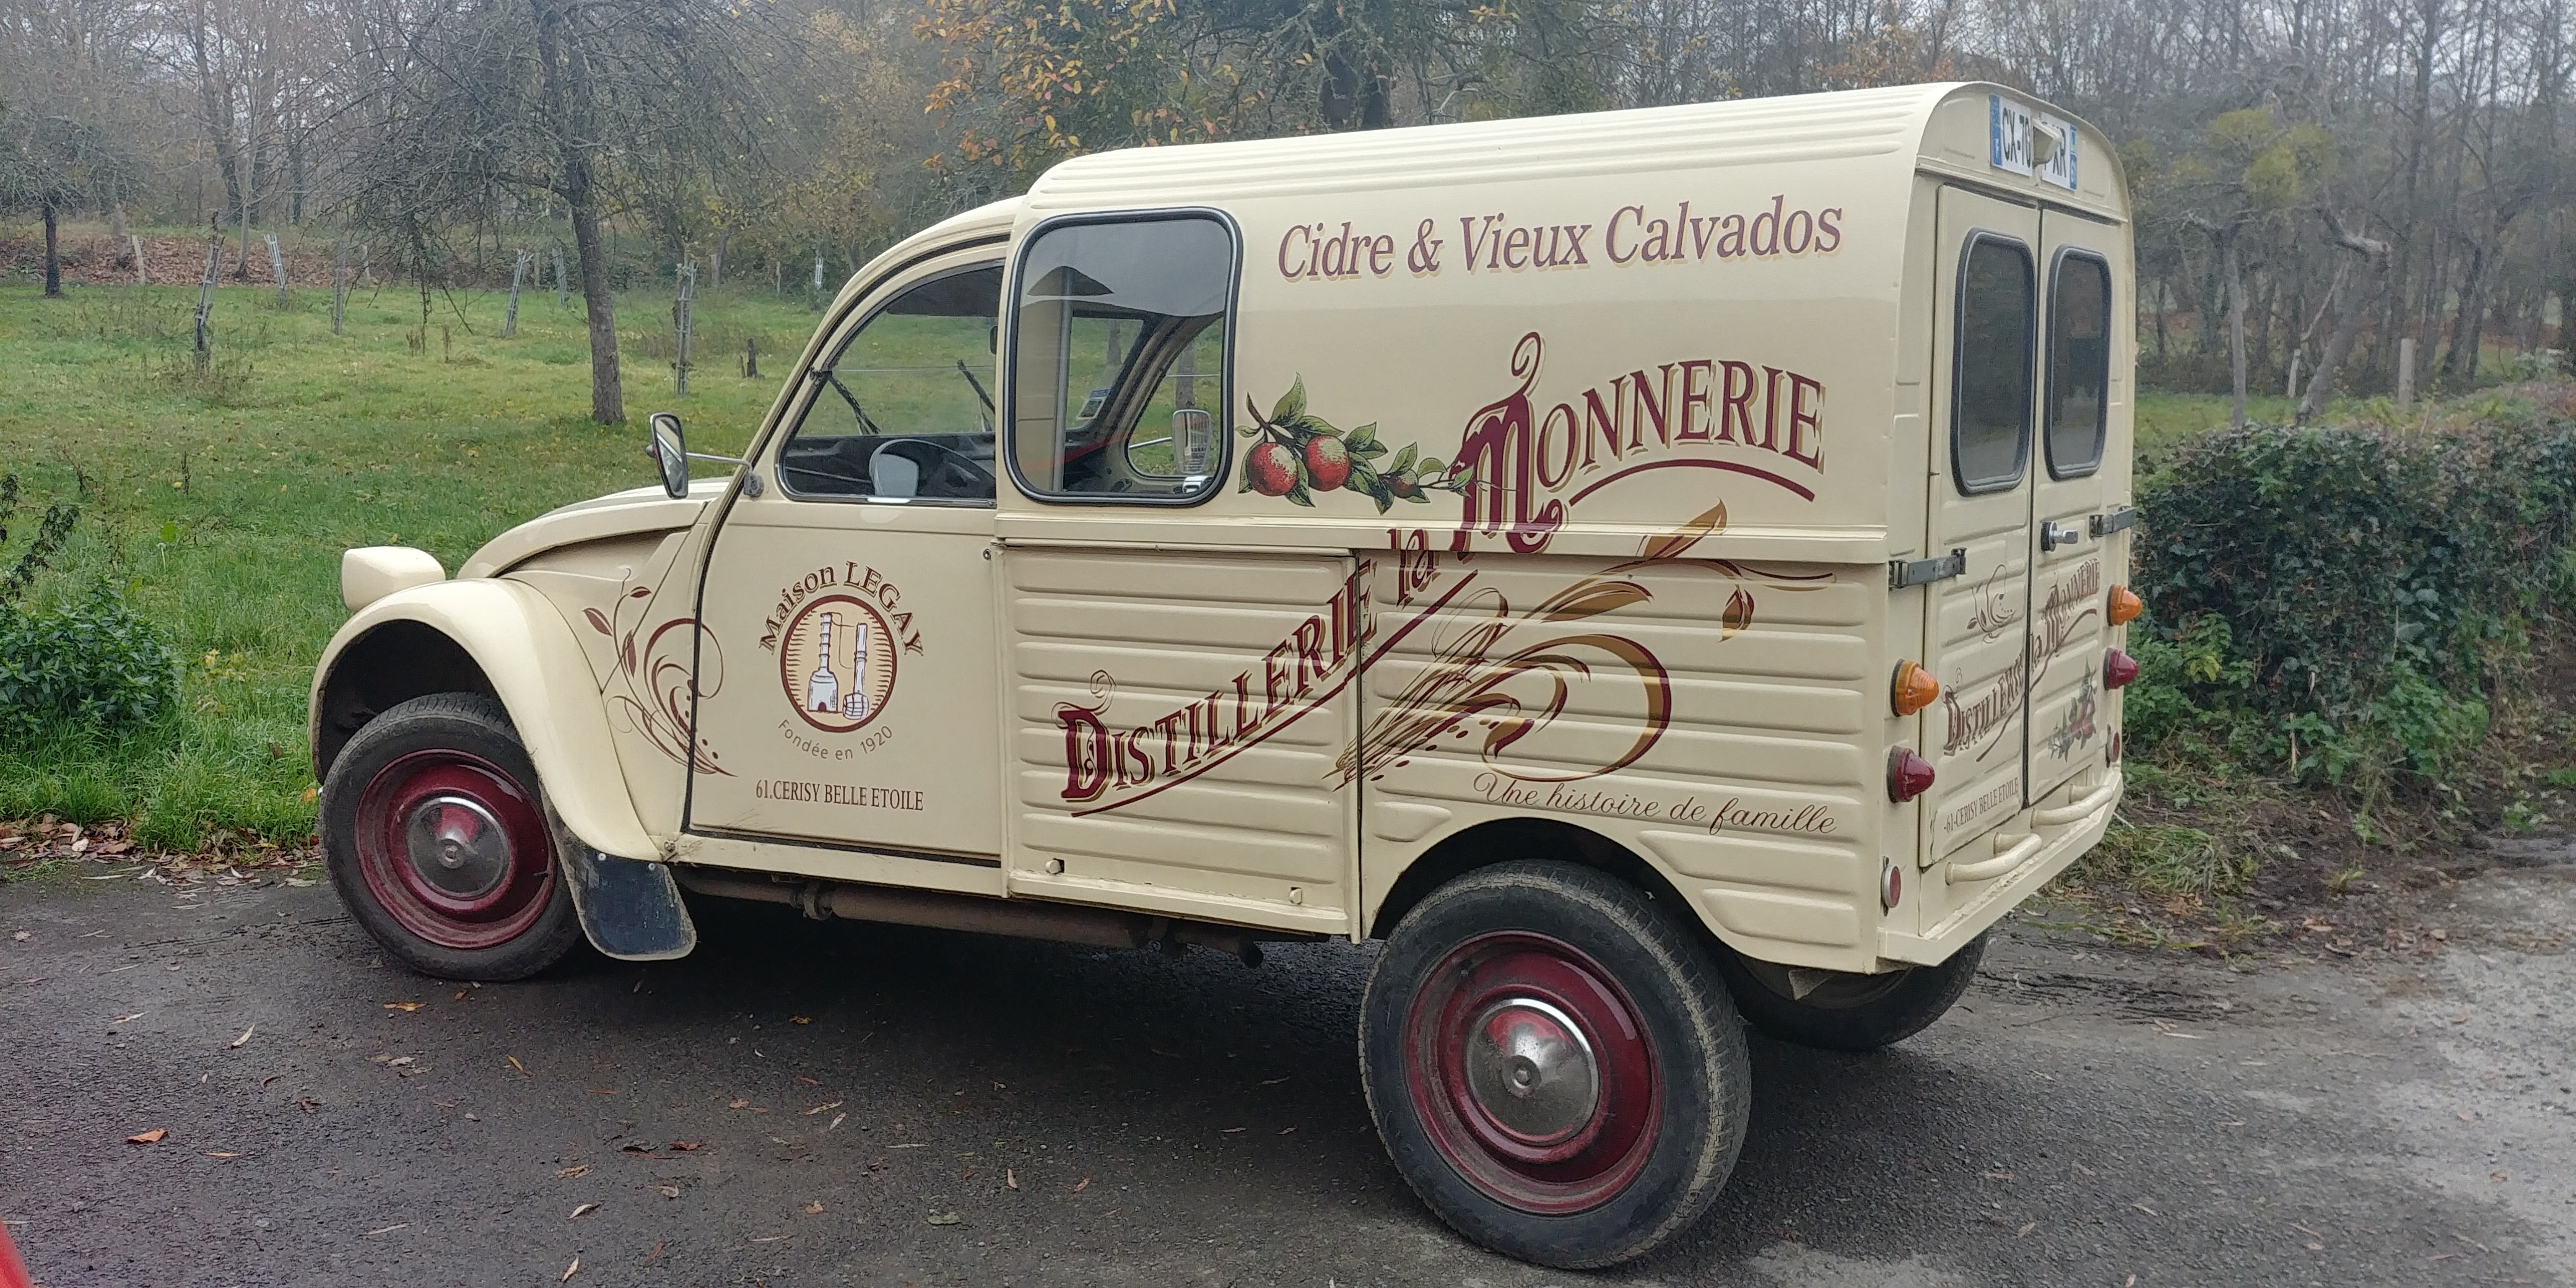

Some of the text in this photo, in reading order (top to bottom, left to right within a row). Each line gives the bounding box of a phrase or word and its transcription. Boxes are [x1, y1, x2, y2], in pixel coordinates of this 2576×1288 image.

[1279, 194, 1845, 284] Cidre & Vieux Calvados
[1386, 528, 1442, 607] la
[1448, 331, 1825, 563] MONNERIE
[759, 560, 924, 656] Maison LEGAY
[778, 719, 894, 760] Fondée en 1920
[755, 779, 924, 811] 61.CERISY BELLE ETOILE
[1473, 772, 1838, 835] Une histoire de famille
[1979, 788, 1998, 814] BELLE
[1998, 777, 2019, 803] ETOILE
